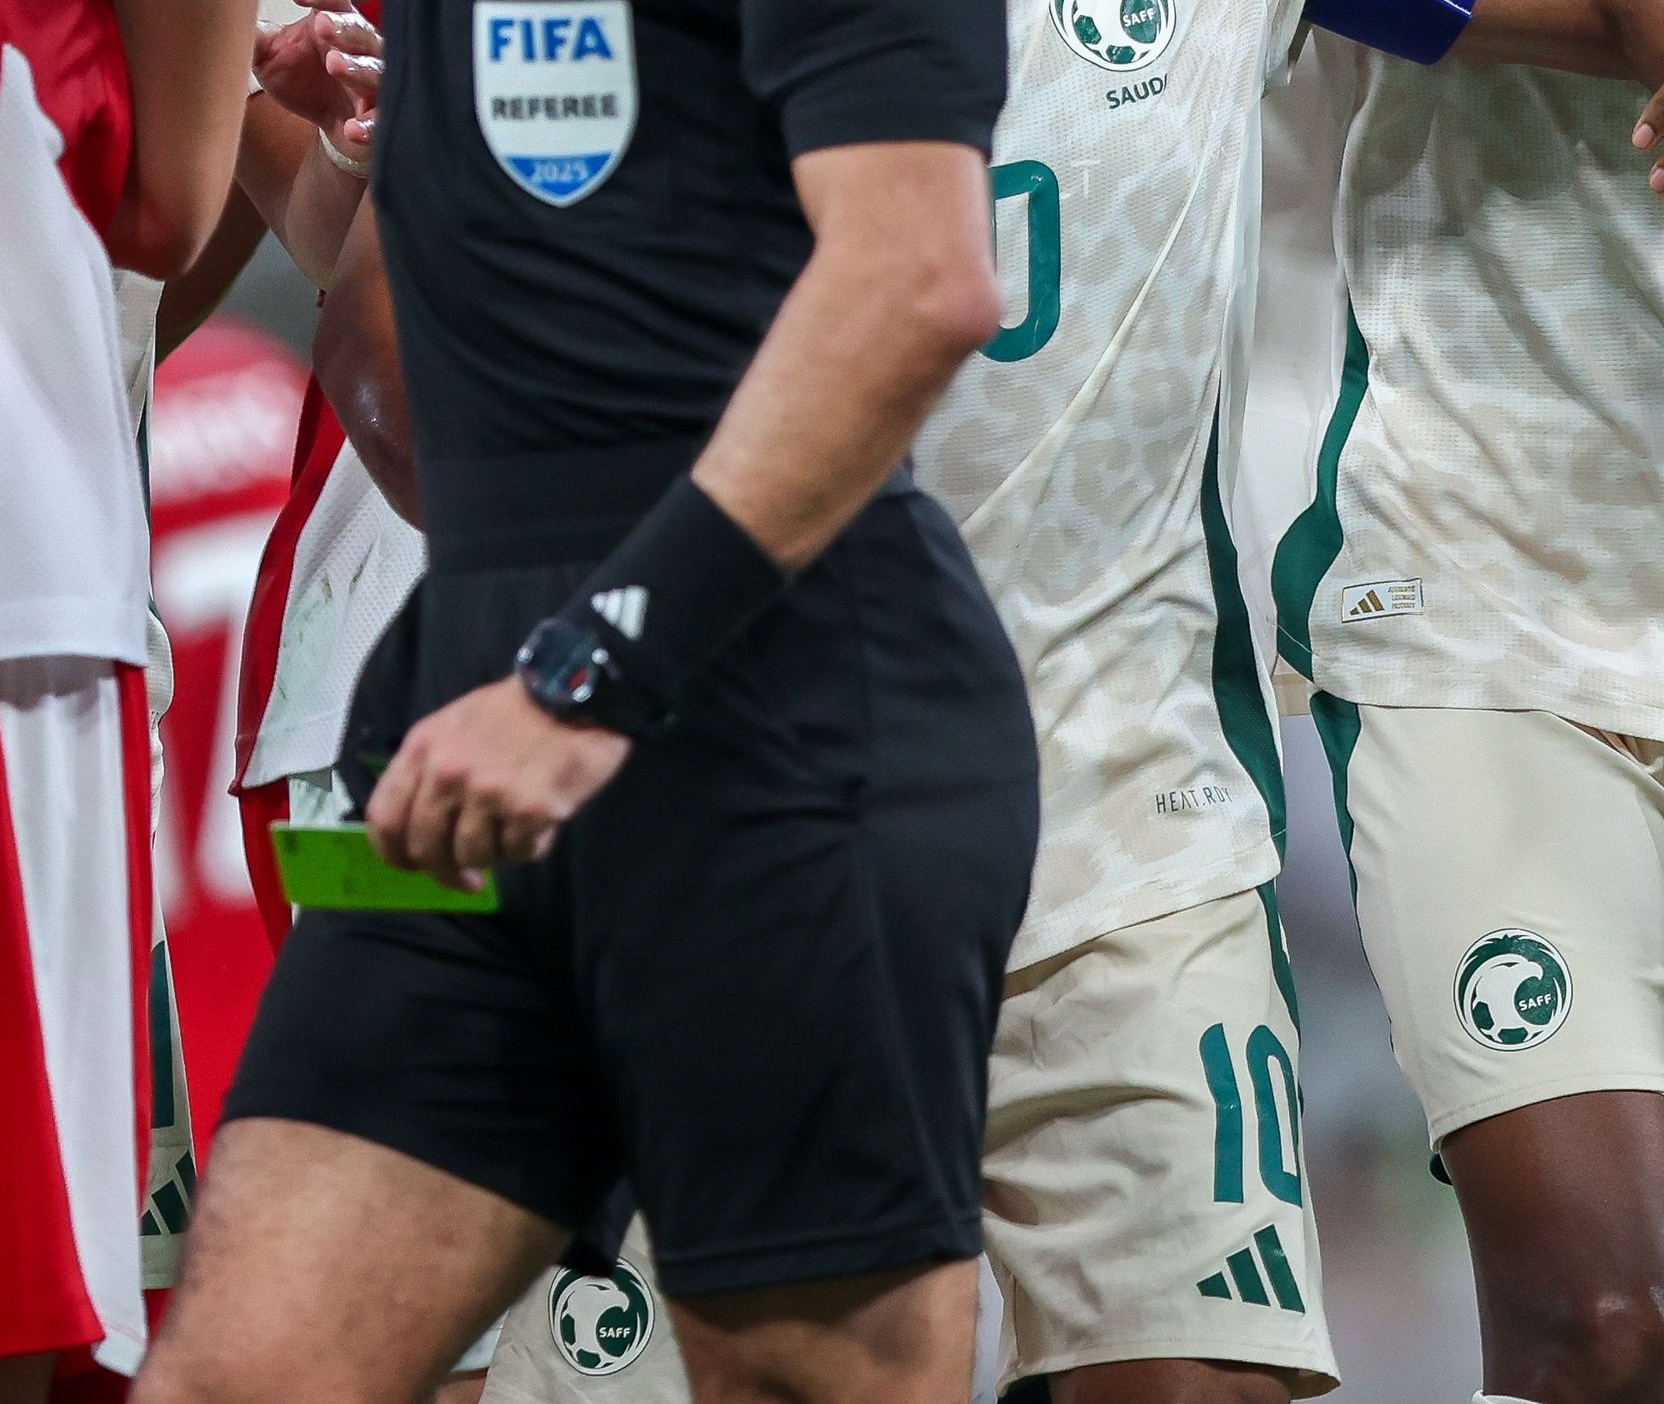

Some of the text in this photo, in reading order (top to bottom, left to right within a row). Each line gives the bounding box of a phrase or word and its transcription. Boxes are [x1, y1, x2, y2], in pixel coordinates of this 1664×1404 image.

[1122, 7, 1156, 28] SAFF
[489, 17, 615, 62] FIFA
[491, 93, 618, 121] REFEREE
[1155, 786, 1233, 814] HEAT.RDY
[1518, 993, 1552, 1011] SAFF
[1199, 1022, 1303, 1209] 10
[599, 1326, 631, 1339] SAFF
